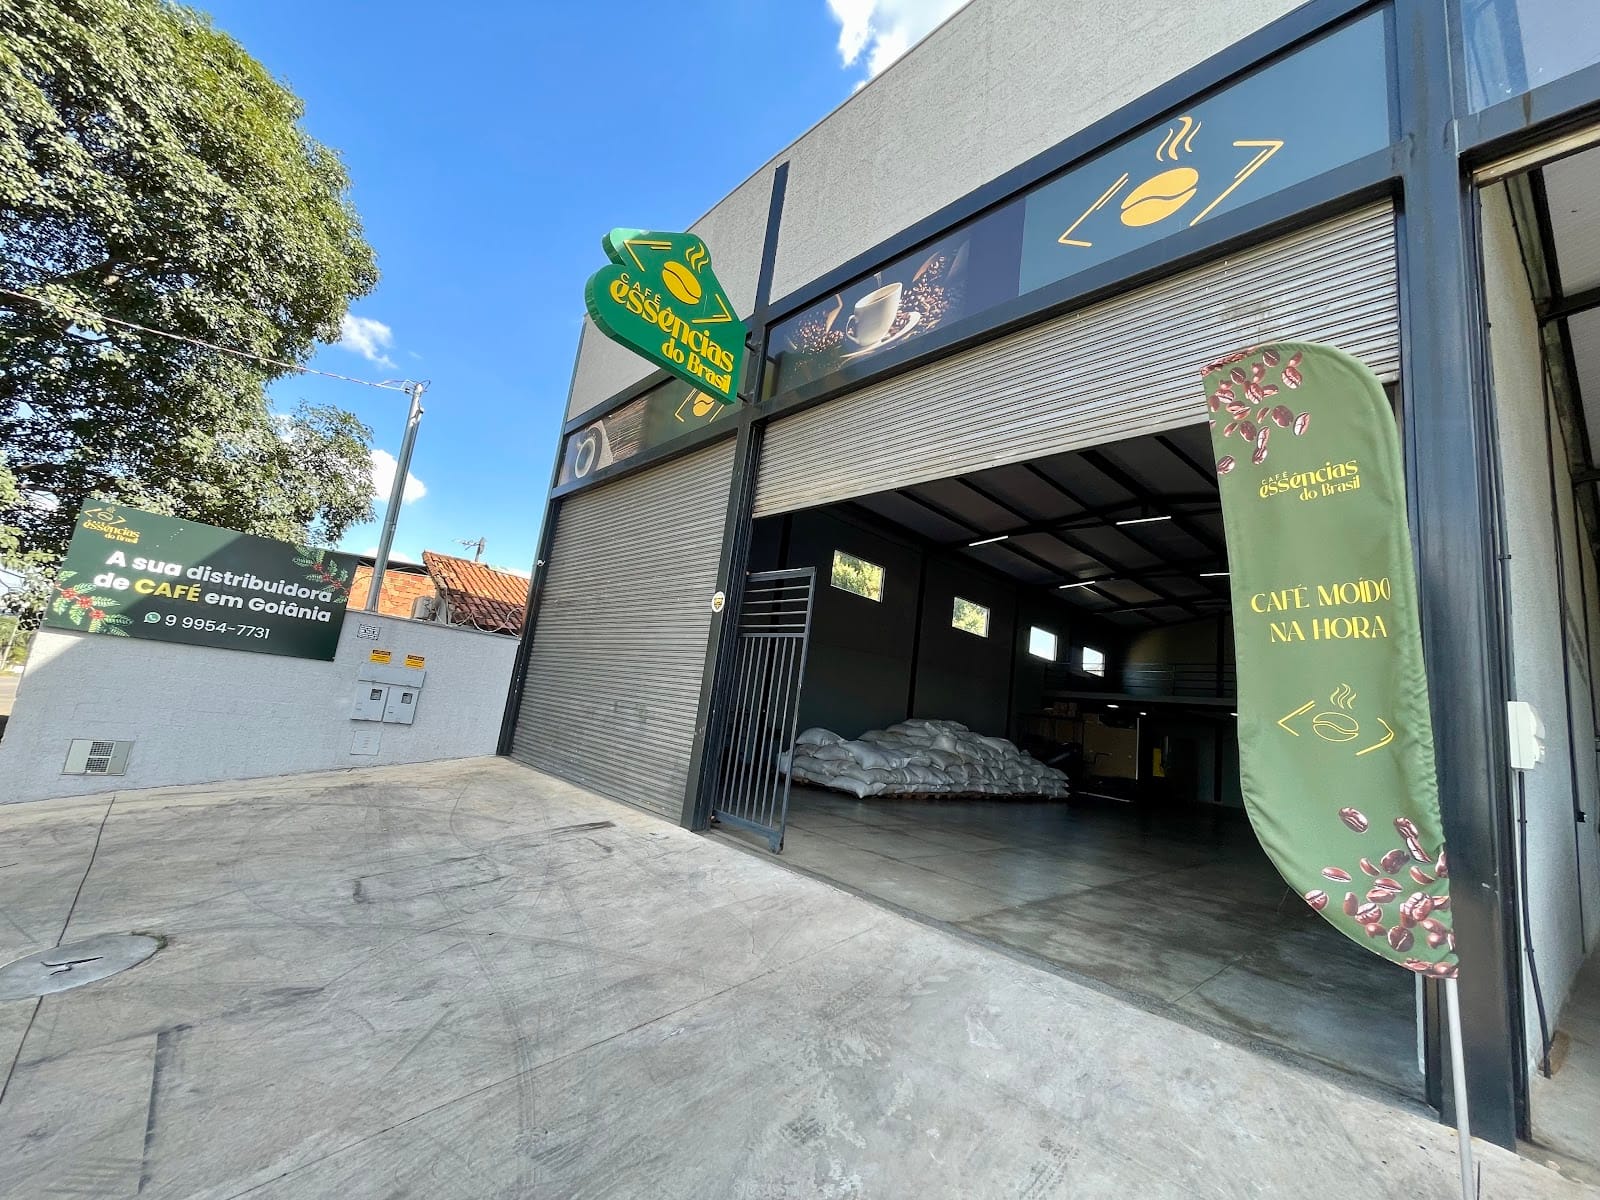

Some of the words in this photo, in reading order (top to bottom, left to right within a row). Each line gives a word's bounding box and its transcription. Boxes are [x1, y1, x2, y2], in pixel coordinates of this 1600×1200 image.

[620, 273, 661, 305] CAFÉ
[610, 279, 734, 373] essências
[661, 339, 685, 364] do
[686, 352, 732, 394] Brasil
[1259, 460, 1359, 498] essências
[1261, 471, 1289, 485] CAFÉ
[1299, 488, 1318, 501] do
[1321, 475, 1361, 497] Brasil
[105, 550, 126, 567] A
[131, 557, 182, 577] sua
[186, 566, 332, 603] distribuidora
[93, 572, 130, 591] de
[134, 578, 202, 602] CAFÉ
[205, 591, 243, 609] em
[248, 597, 331, 623] Goiânia
[1250, 583, 1310, 613] CAFÉ
[1318, 577, 1391, 607] MOÍDO
[165, 614, 176, 627] 9
[182, 616, 271, 640] 9954-7731
[1270, 621, 1305, 643] NA
[1312, 615, 1388, 641] HORA
